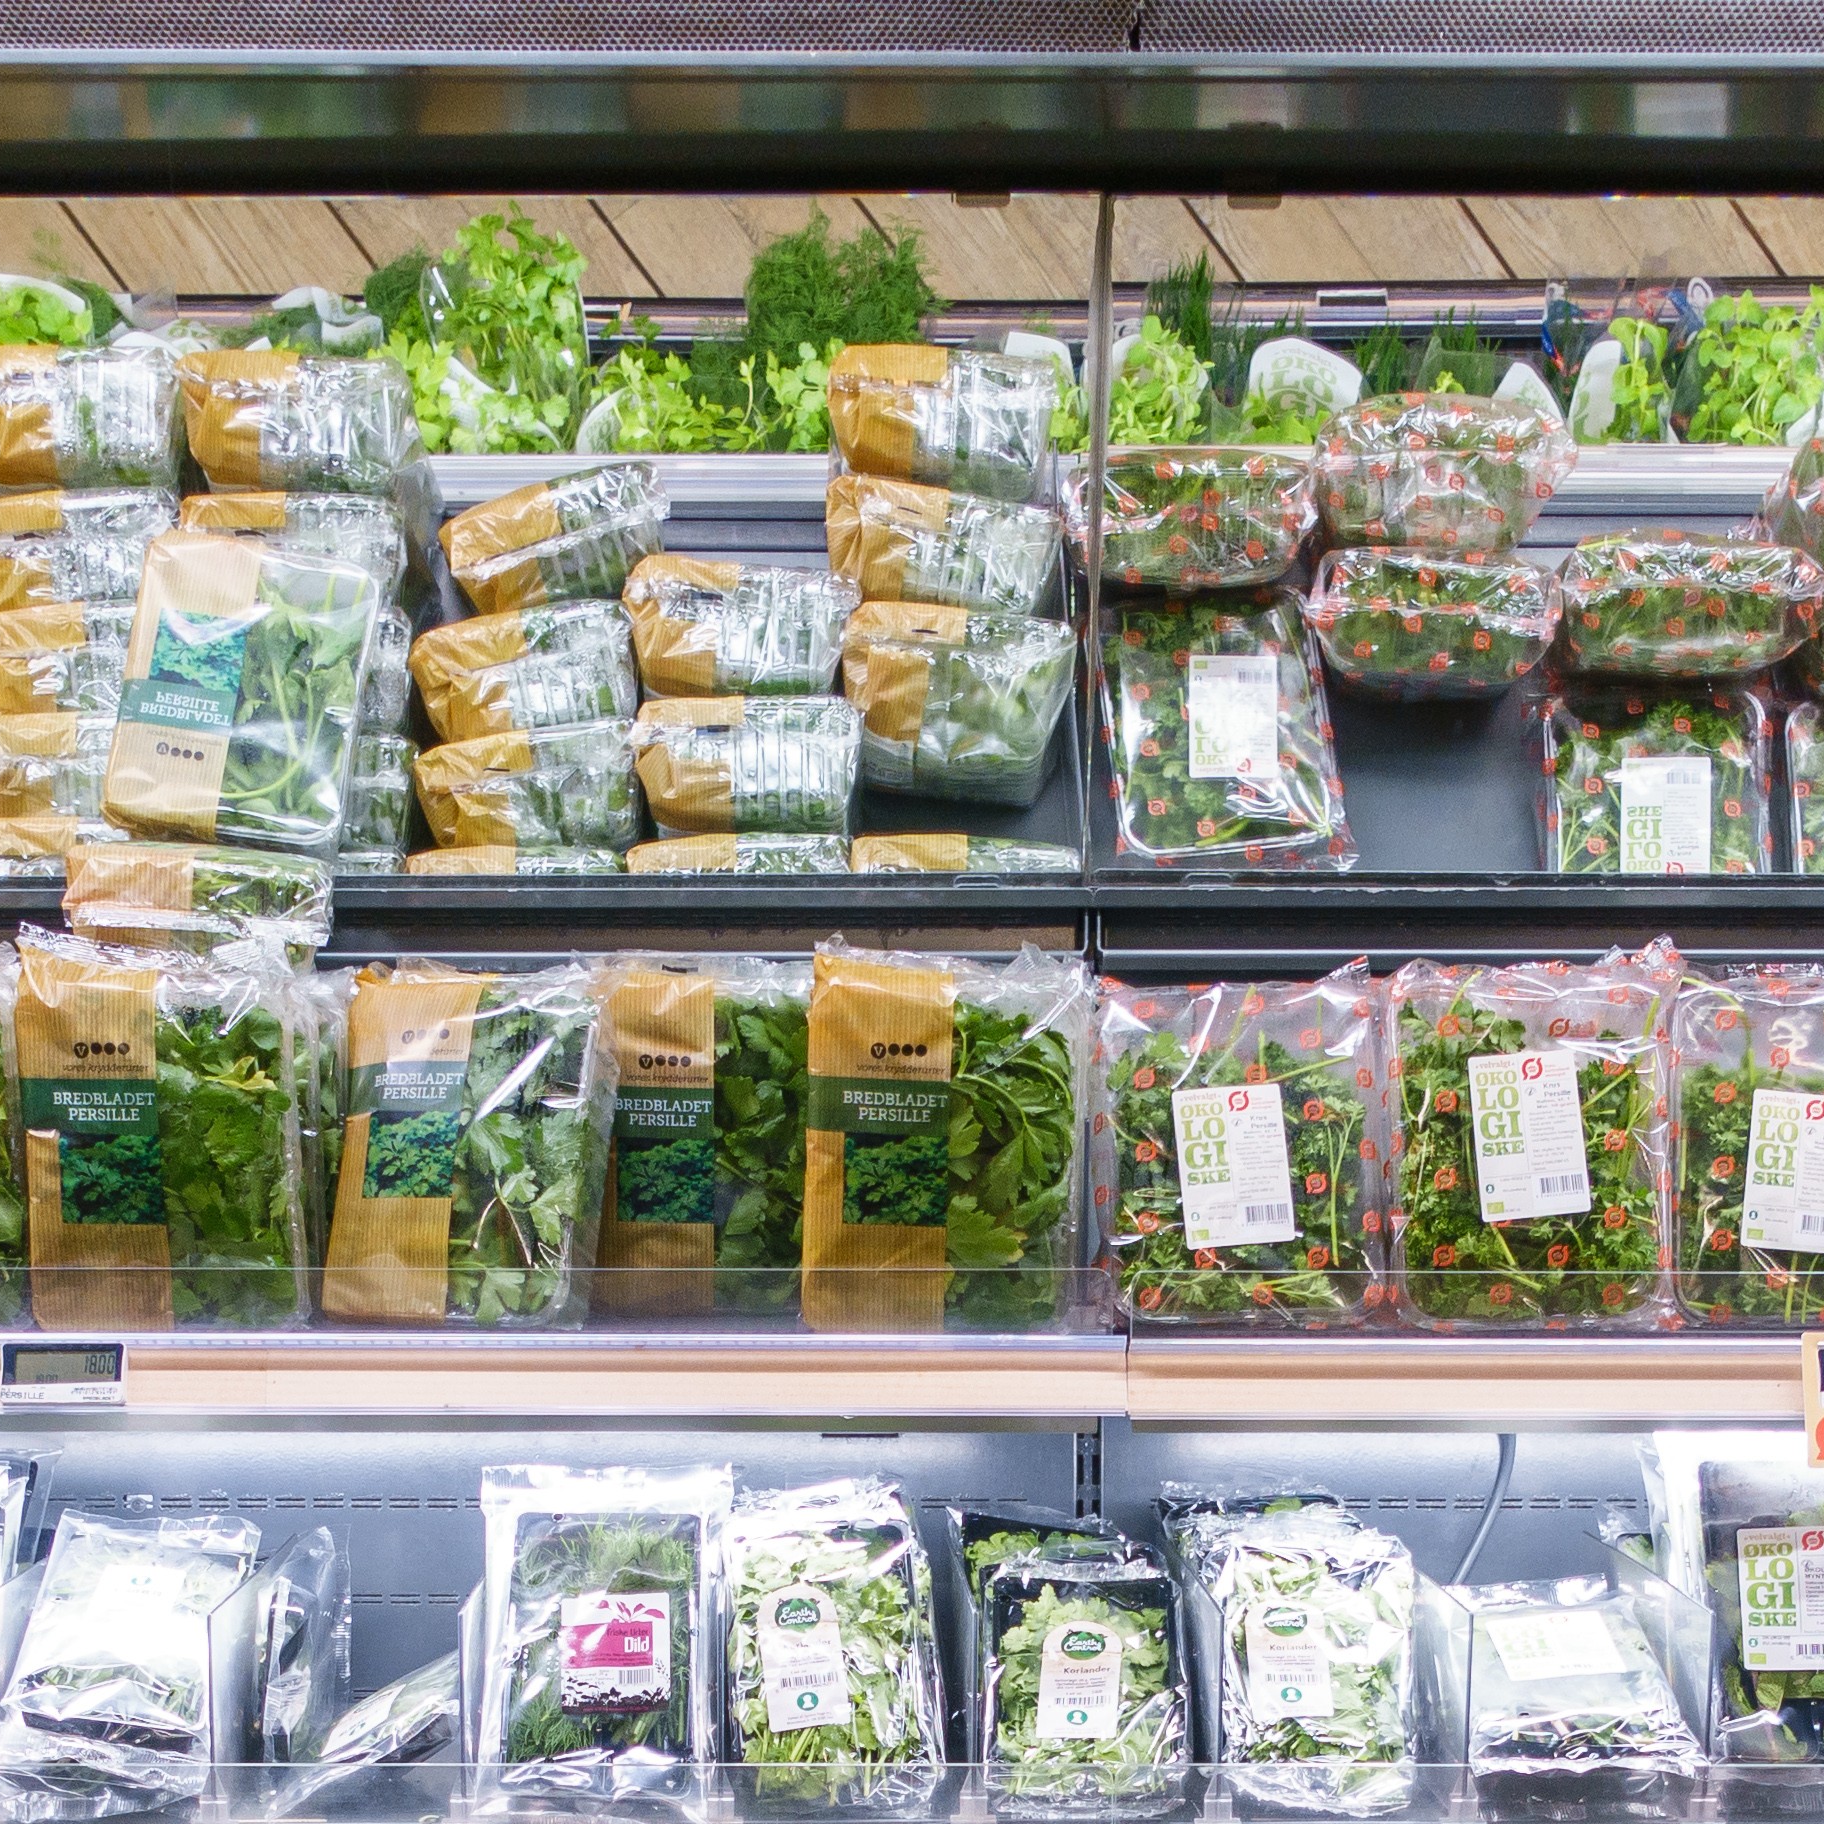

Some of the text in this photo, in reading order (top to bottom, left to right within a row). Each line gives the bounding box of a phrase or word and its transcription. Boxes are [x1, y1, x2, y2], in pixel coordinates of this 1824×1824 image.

[375, 1072, 464, 1089] BREDBLADET
[1475, 1067, 1518, 1086] ØKO
[53, 1091, 155, 1108] BREDBLADET
[383, 1084, 447, 1101] PERSILLE
[843, 1091, 948, 1110] BREDBLADET
[1477, 1084, 1520, 1112] LO
[68, 1107, 140, 1123] PERSILLE
[616, 1098, 712, 1116] BREDBLADET
[858, 1107, 931, 1124] PERSILLE
[1180, 1100, 1223, 1119] ØKO
[628, 1113, 697, 1129] PERSILLE
[1181, 1117, 1226, 1142] LO
[1480, 1110, 1523, 1142] GI
[1184, 1140, 1229, 1171] GI
[1482, 1140, 1525, 1157] SKE
[1186, 1169, 1231, 1187] SKE
[0, 1390, 45, 1400] PERSILLE
[1743, 1540, 1793, 1558] ØKO
[1746, 1555, 1795, 1584] LO
[1746, 1581, 1798, 1612] GI
[1747, 1609, 1798, 1629] SKE
[624, 1635, 650, 1654] Dild
[1063, 1666, 1112, 1676] Koriander
